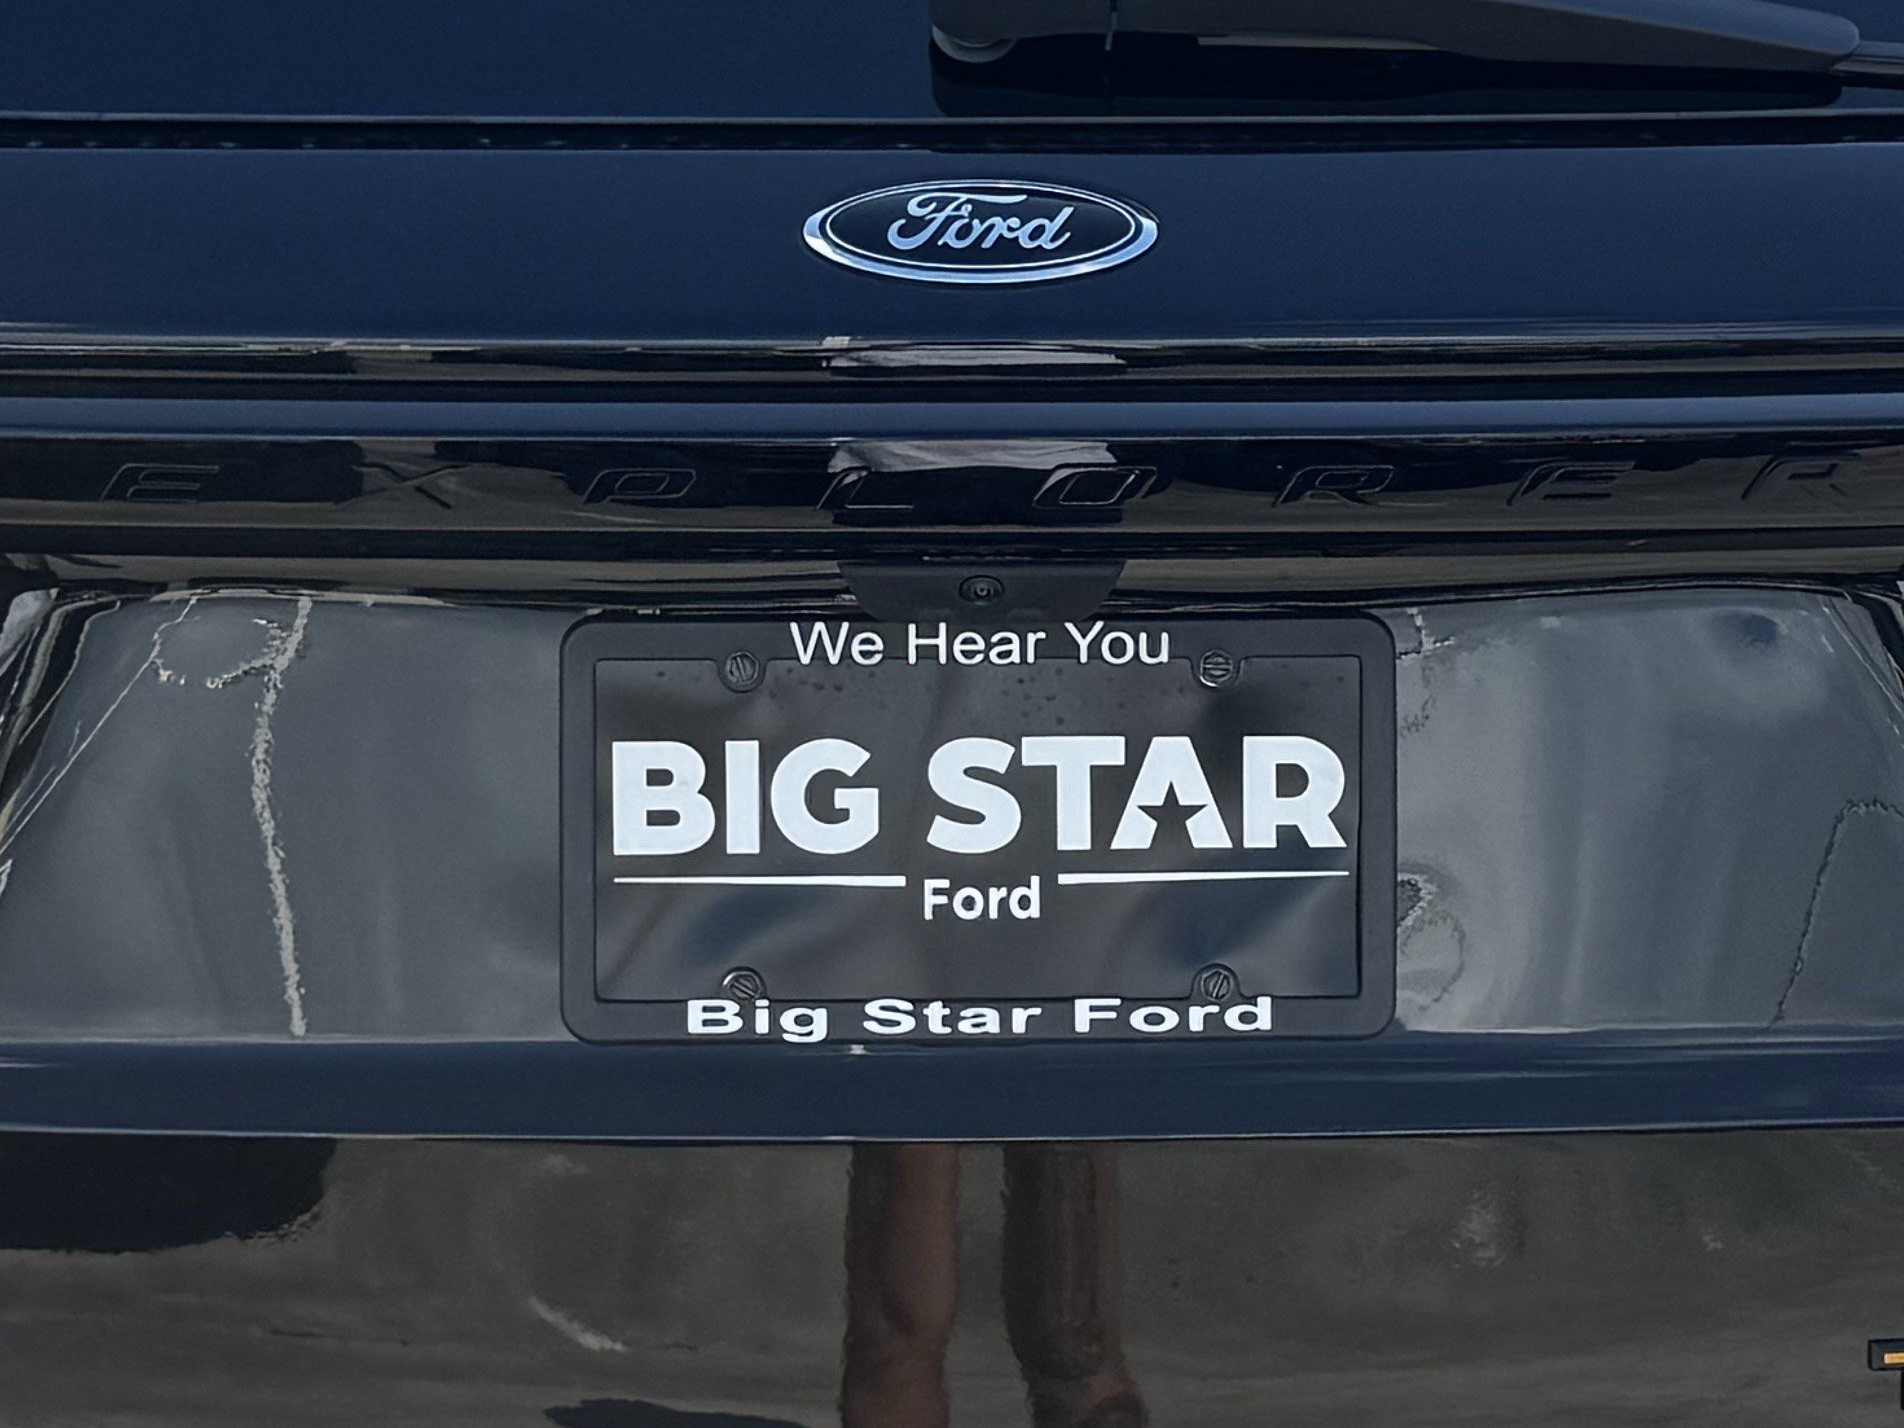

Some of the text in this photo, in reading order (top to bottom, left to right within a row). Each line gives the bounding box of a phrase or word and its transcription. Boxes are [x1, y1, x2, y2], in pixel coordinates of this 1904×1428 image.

[887, 191, 1075, 251] Ford
[99, 453, 1864, 512] EXPLORER
[789, 620, 1169, 666] We Hear You
[611, 735, 1348, 857] BIG STAR
[923, 875, 1041, 921] Ford
[687, 996, 1272, 1043] Big Star Ford
